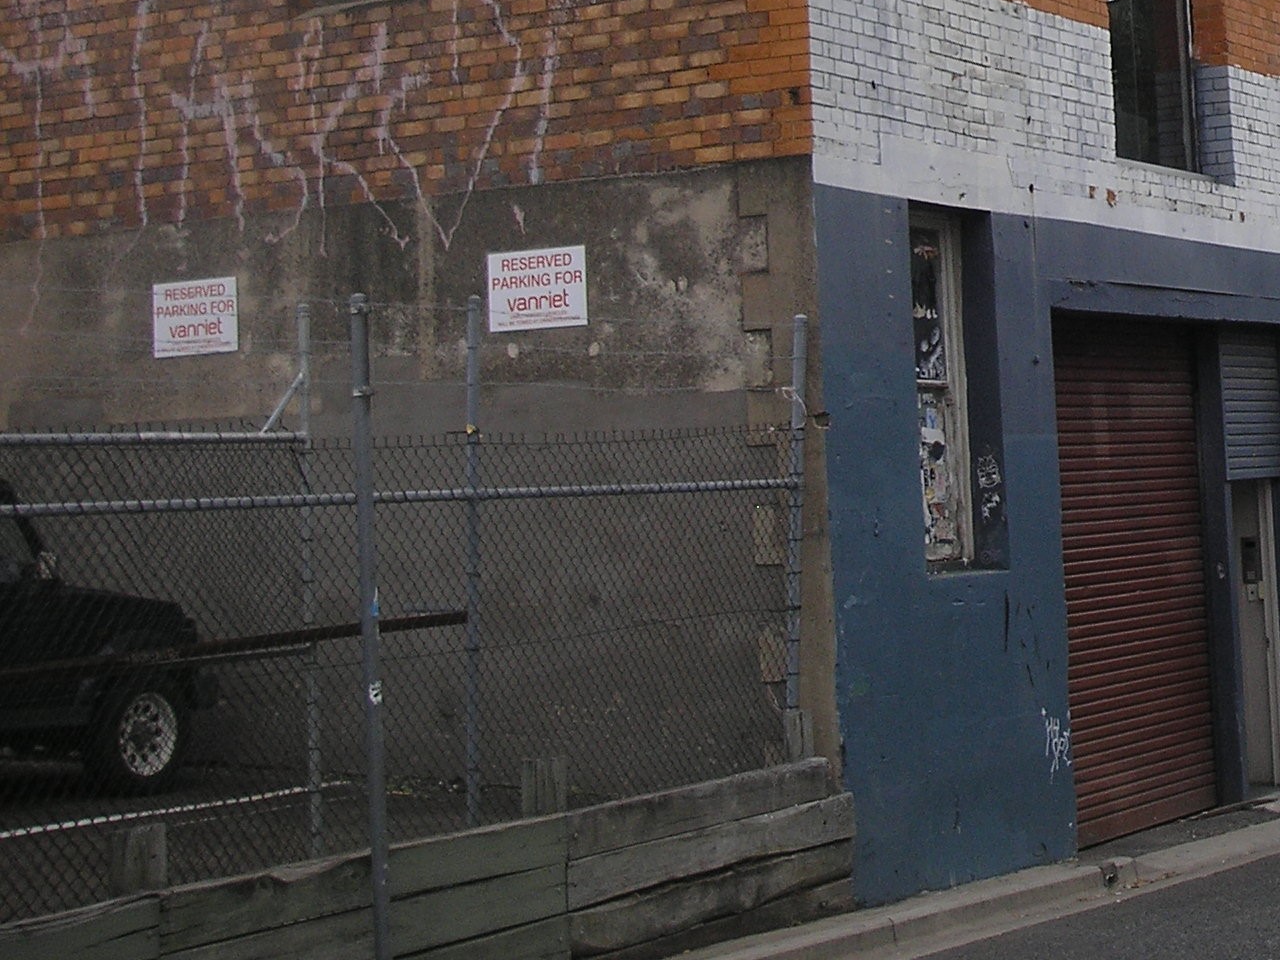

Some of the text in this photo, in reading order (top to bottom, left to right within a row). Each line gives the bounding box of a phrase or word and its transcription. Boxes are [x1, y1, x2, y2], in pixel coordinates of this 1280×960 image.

[501, 253, 572, 272] RESERVED
[492, 270, 583, 291] PARKING FOR
[164, 283, 226, 301] RESERVED
[507, 288, 570, 312] vanriet
[156, 300, 234, 318] PARKING FOR
[169, 317, 223, 338] vanriet
